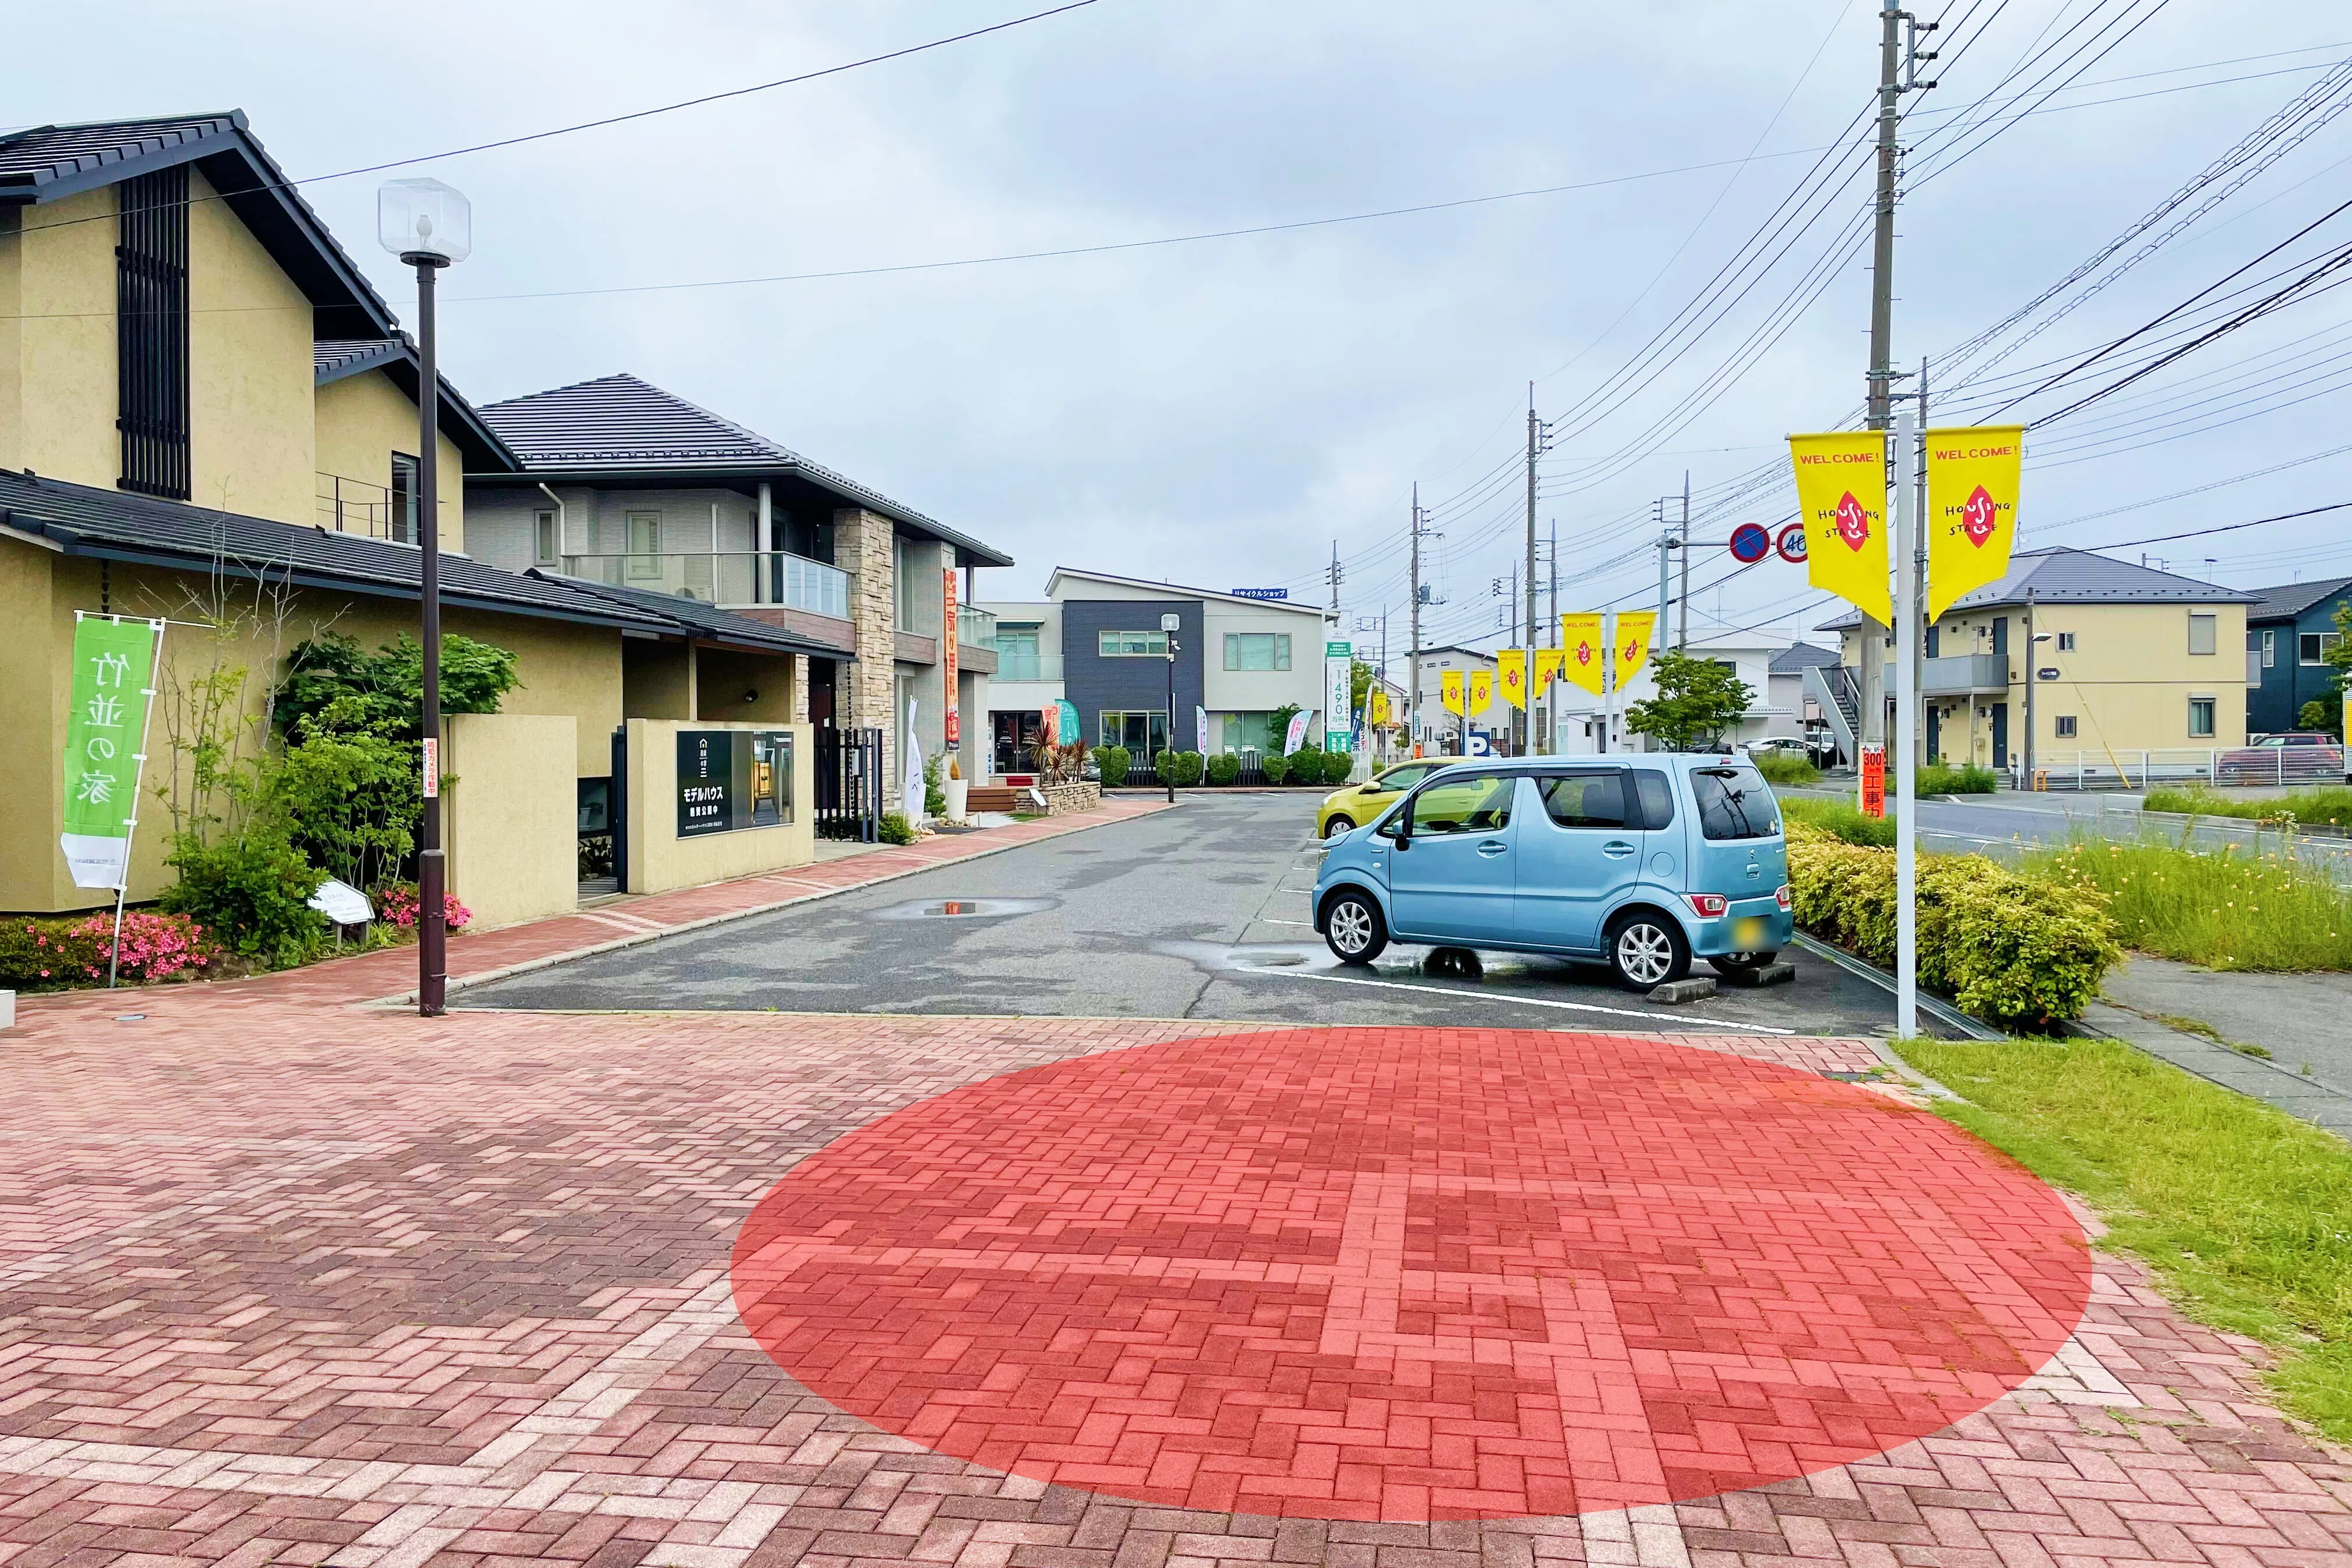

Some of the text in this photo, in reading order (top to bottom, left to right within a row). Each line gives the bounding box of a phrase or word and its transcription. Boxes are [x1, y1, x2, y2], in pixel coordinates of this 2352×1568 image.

[1800, 453, 1879, 464] WELCOME!
[1936, 446, 2017, 460] WELCOME!
[1786, 534, 1807, 552] 40
[1468, 737, 1488, 757] P
[427, 741, 435, 794] 防犯カメラ作動中
[1864, 753, 1882, 766] 300
[684, 786, 723, 803] モデルハウス
[1865, 775, 1881, 818] 工事中
